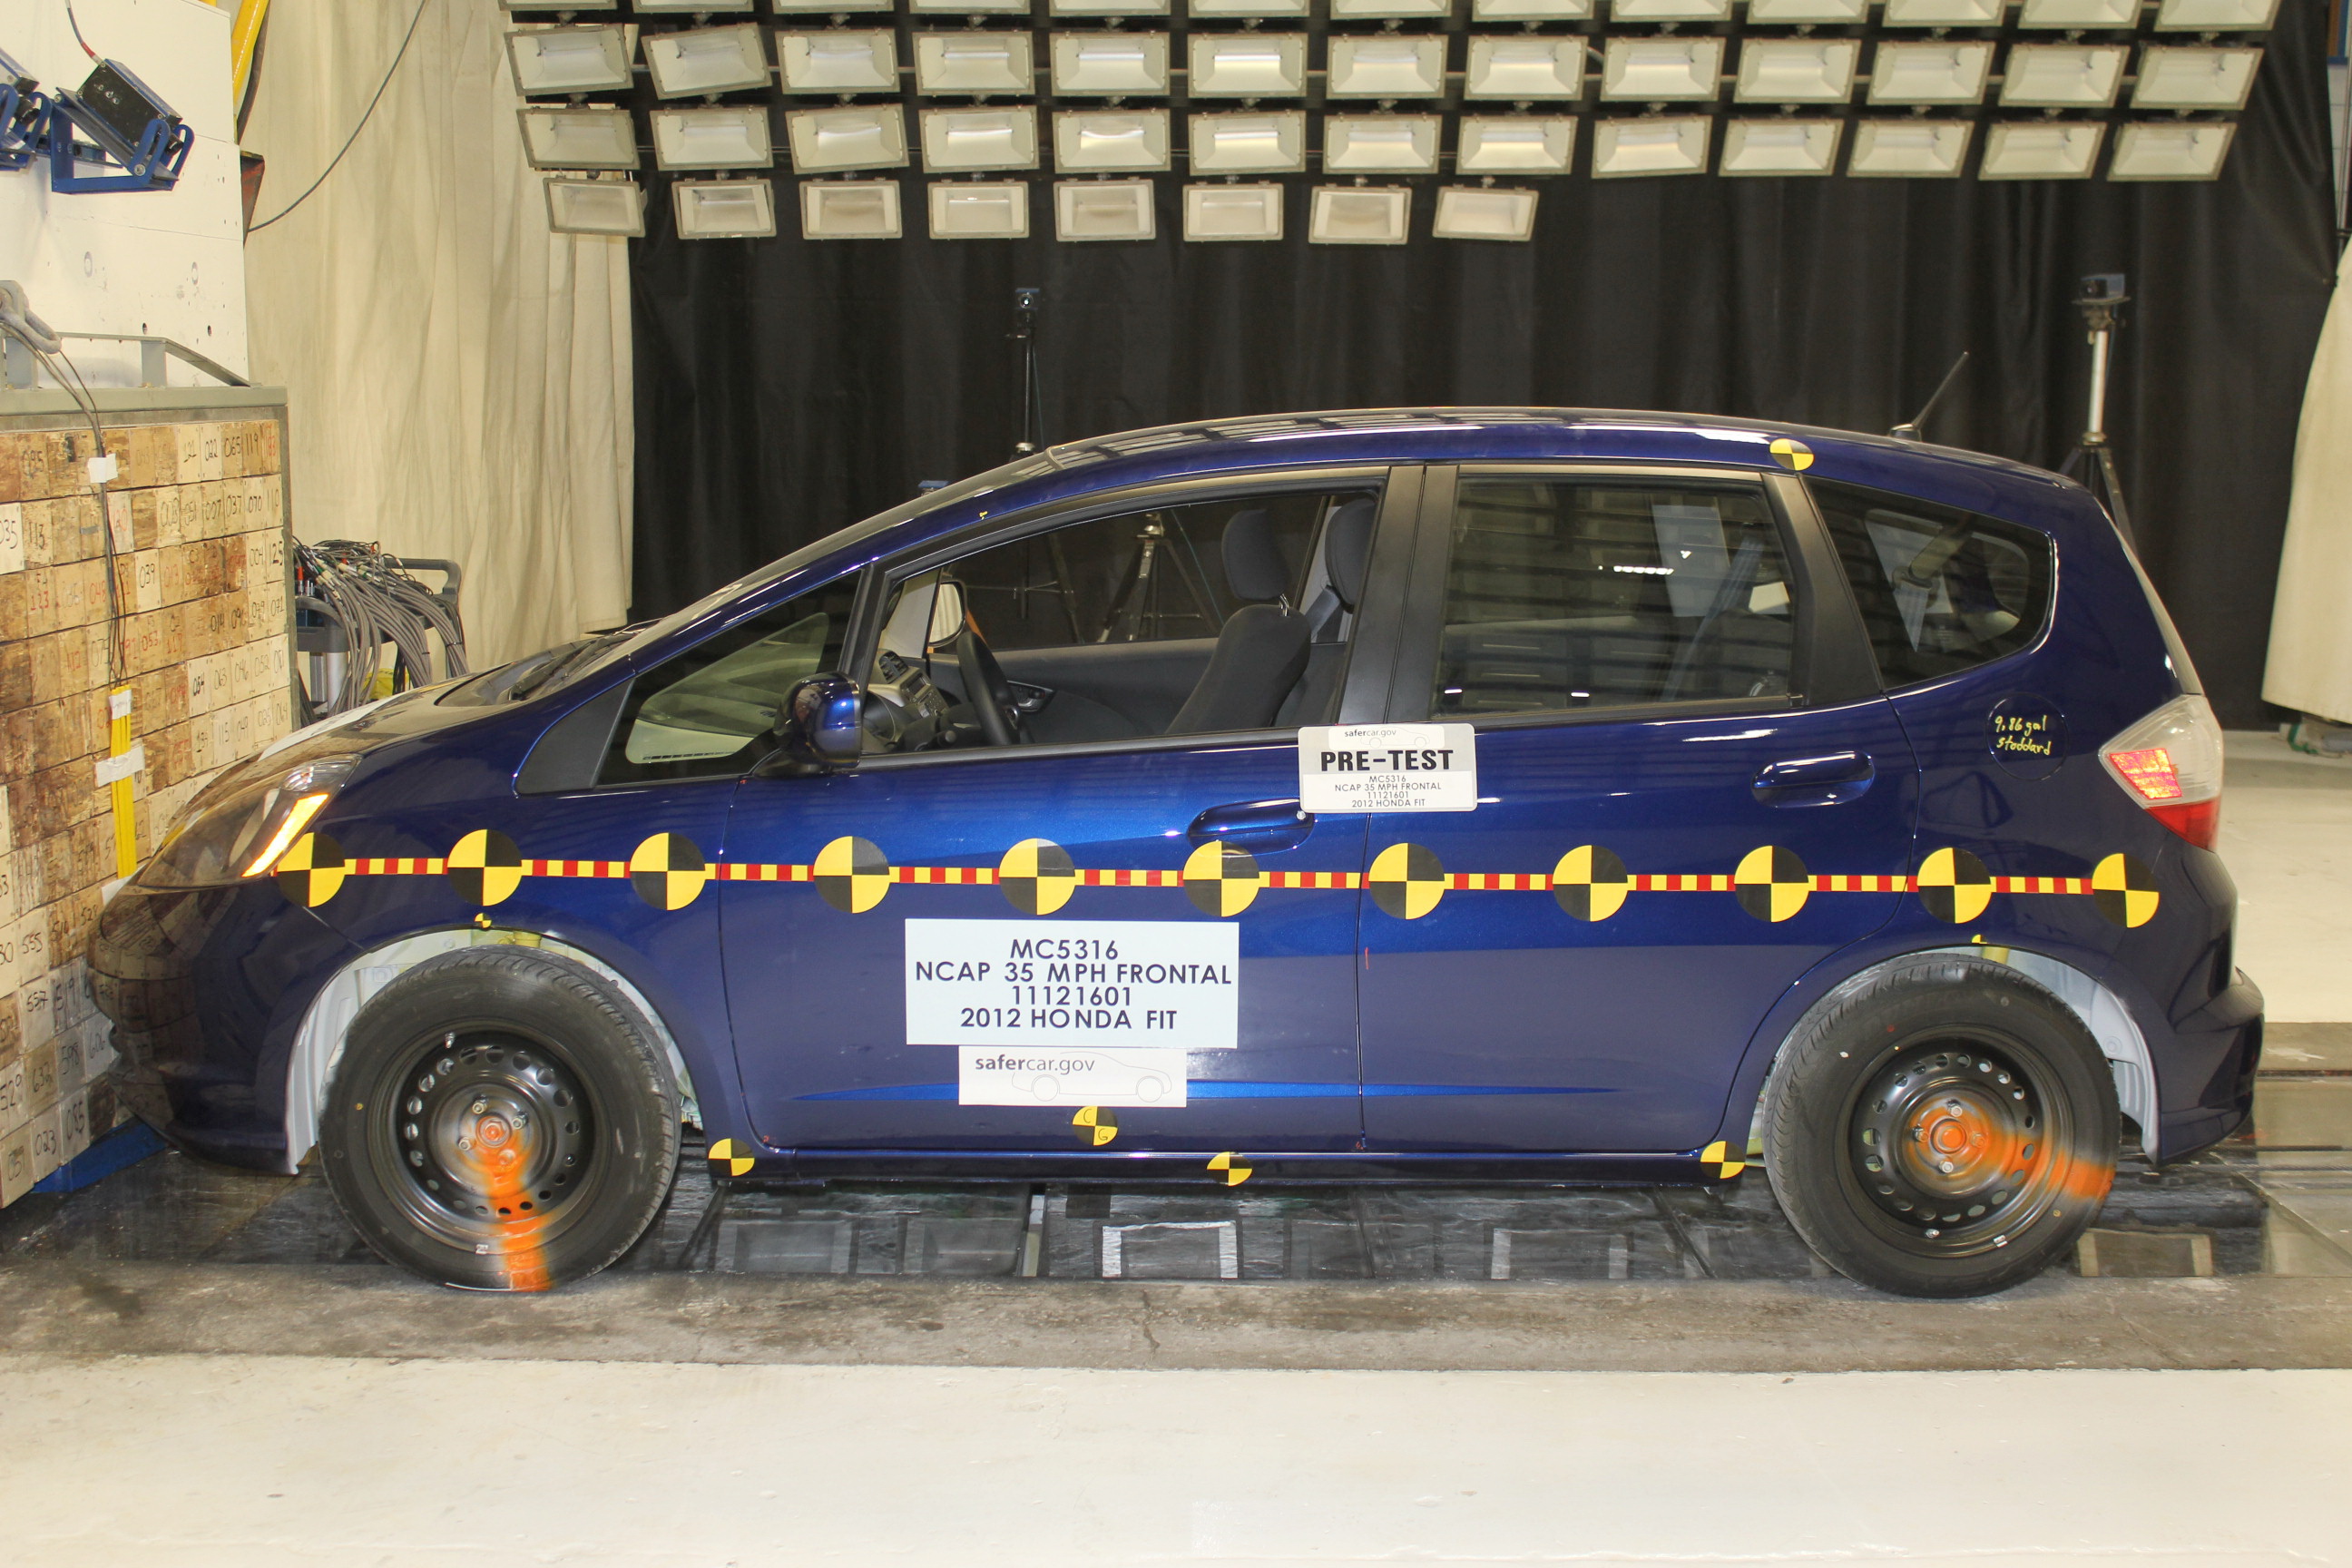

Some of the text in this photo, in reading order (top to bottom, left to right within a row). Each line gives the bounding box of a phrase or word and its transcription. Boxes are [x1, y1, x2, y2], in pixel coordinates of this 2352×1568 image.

[225, 436, 242, 458] 065
[245, 433, 260, 456] 119
[227, 495, 242, 517] 037
[139, 563, 155, 589] 039
[1344, 728, 1396, 738] safercar.gov
[2024, 714, 2047, 737] gal
[1996, 735, 2052, 756] stoddard
[1320, 749, 1454, 772] PRE-TEST
[1334, 782, 1442, 792] NCAP 35 MPH FRONTAL
[1368, 775, 1406, 783] MC5316
[1351, 799, 1426, 808] 2012 HONDA FIT
[1367, 791, 1409, 799] 11121601
[21, 931, 43, 955] 555
[1009, 938, 1119, 961] MC5316
[915, 961, 1232, 985] NCAP 35 MPH FRONTAL
[1012, 985, 1132, 1006] 11121601
[960, 1007, 1178, 1030] 2012 HONDA FIT
[975, 1053, 1096, 1076] safercar.gov
